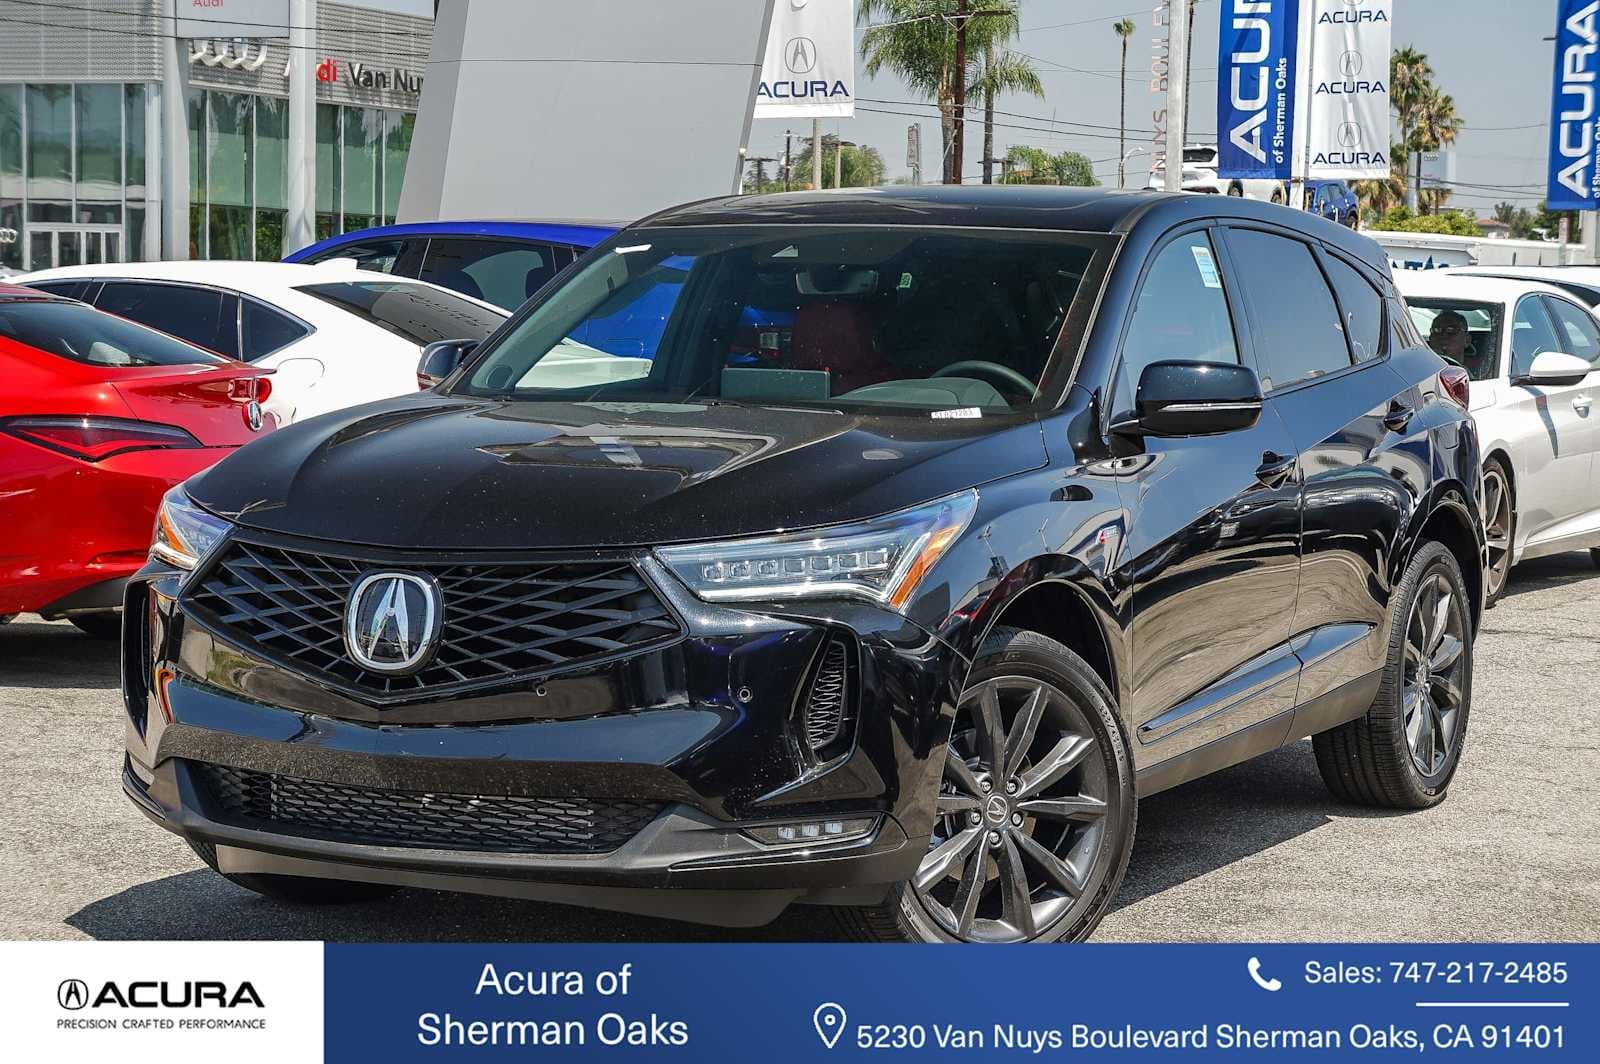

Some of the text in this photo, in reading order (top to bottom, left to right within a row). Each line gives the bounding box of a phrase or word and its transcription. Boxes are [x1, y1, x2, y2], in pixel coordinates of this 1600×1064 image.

[1318, 10, 1388, 24] ACURA
[347, 62, 387, 88] Van
[393, 67, 424, 93] Nu
[757, 80, 850, 98] ACURA
[1315, 81, 1386, 95] ACURA
[1557, 0, 1600, 199] ACURA
[1272, 57, 1288, 164] of Sherman Oaks
[1312, 152, 1386, 165] ACURA
